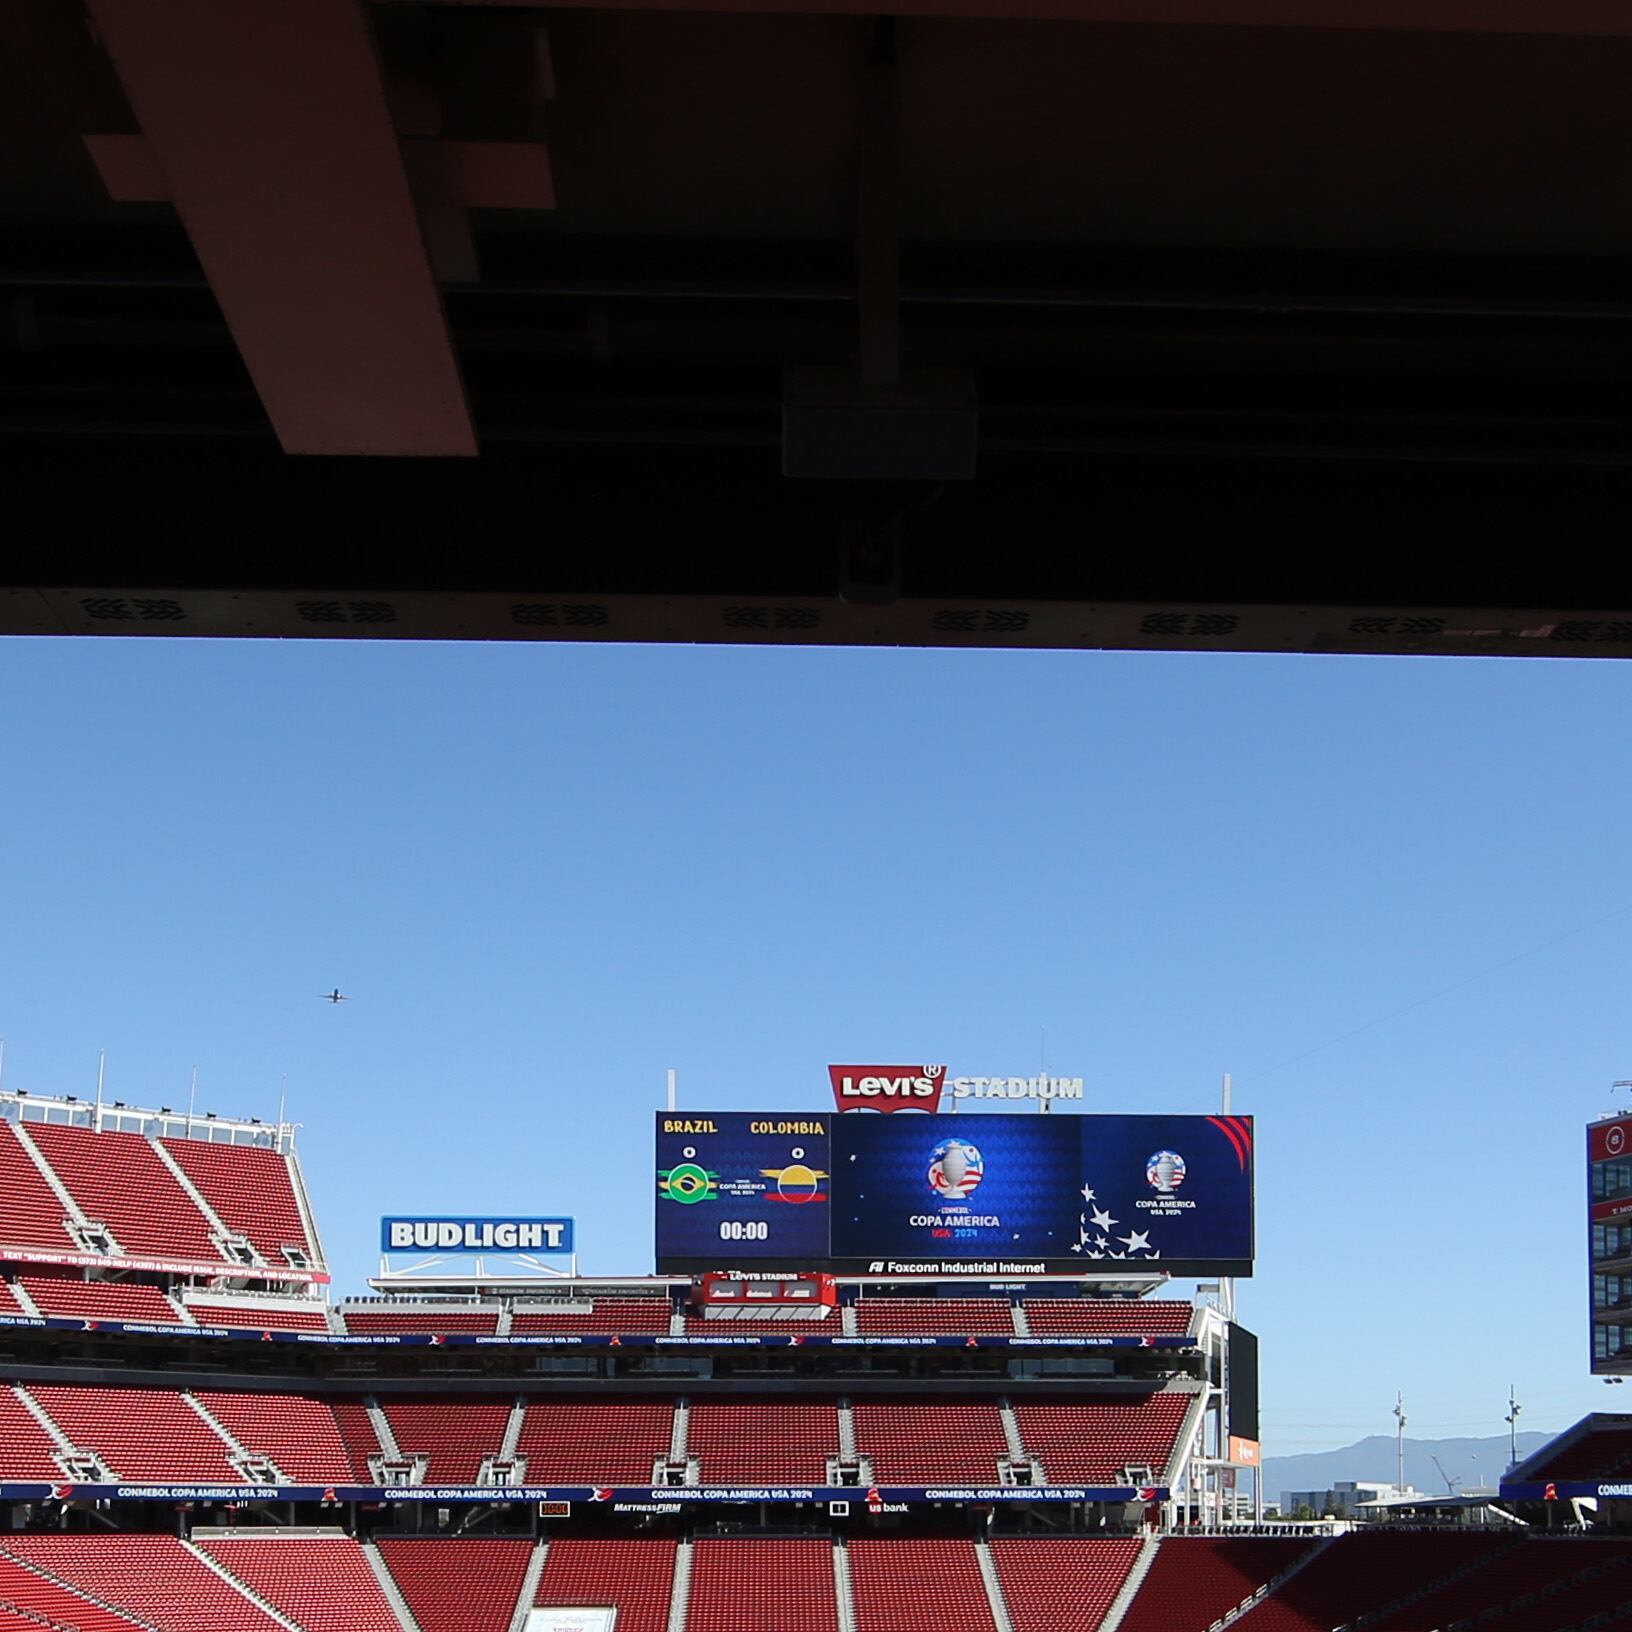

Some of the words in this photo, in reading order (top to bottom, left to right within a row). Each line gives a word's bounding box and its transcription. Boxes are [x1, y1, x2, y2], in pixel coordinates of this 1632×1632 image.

[953, 1076, 1084, 1100] STADIUM
[664, 1120, 719, 1134] BRAZIL
[750, 1121, 825, 1135] COLOMBIA
[682, 1146, 696, 1159] 0
[791, 1147, 805, 1160] 0
[1135, 1200, 1158, 1209] COPA
[1159, 1200, 1196, 1209] AMERICA
[909, 1215, 944, 1227] COPA
[944, 1215, 1000, 1227] AMERICA
[391, 1222, 463, 1247] BUD
[464, 1223, 564, 1248] LIGHT
[720, 1221, 768, 1241] 00:00
[888, 1261, 939, 1273] Foxconn
[941, 1261, 997, 1274] Industrial
[999, 1262, 1046, 1274] Internet
[384, 1490, 434, 1499] CONMEBOL
[436, 1490, 461, 1499] COPA
[461, 1490, 505, 1499] AMERICA
[506, 1490, 524, 1499] USA
[525, 1490, 547, 1499] 2024
[883, 1502, 909, 1512] bank
